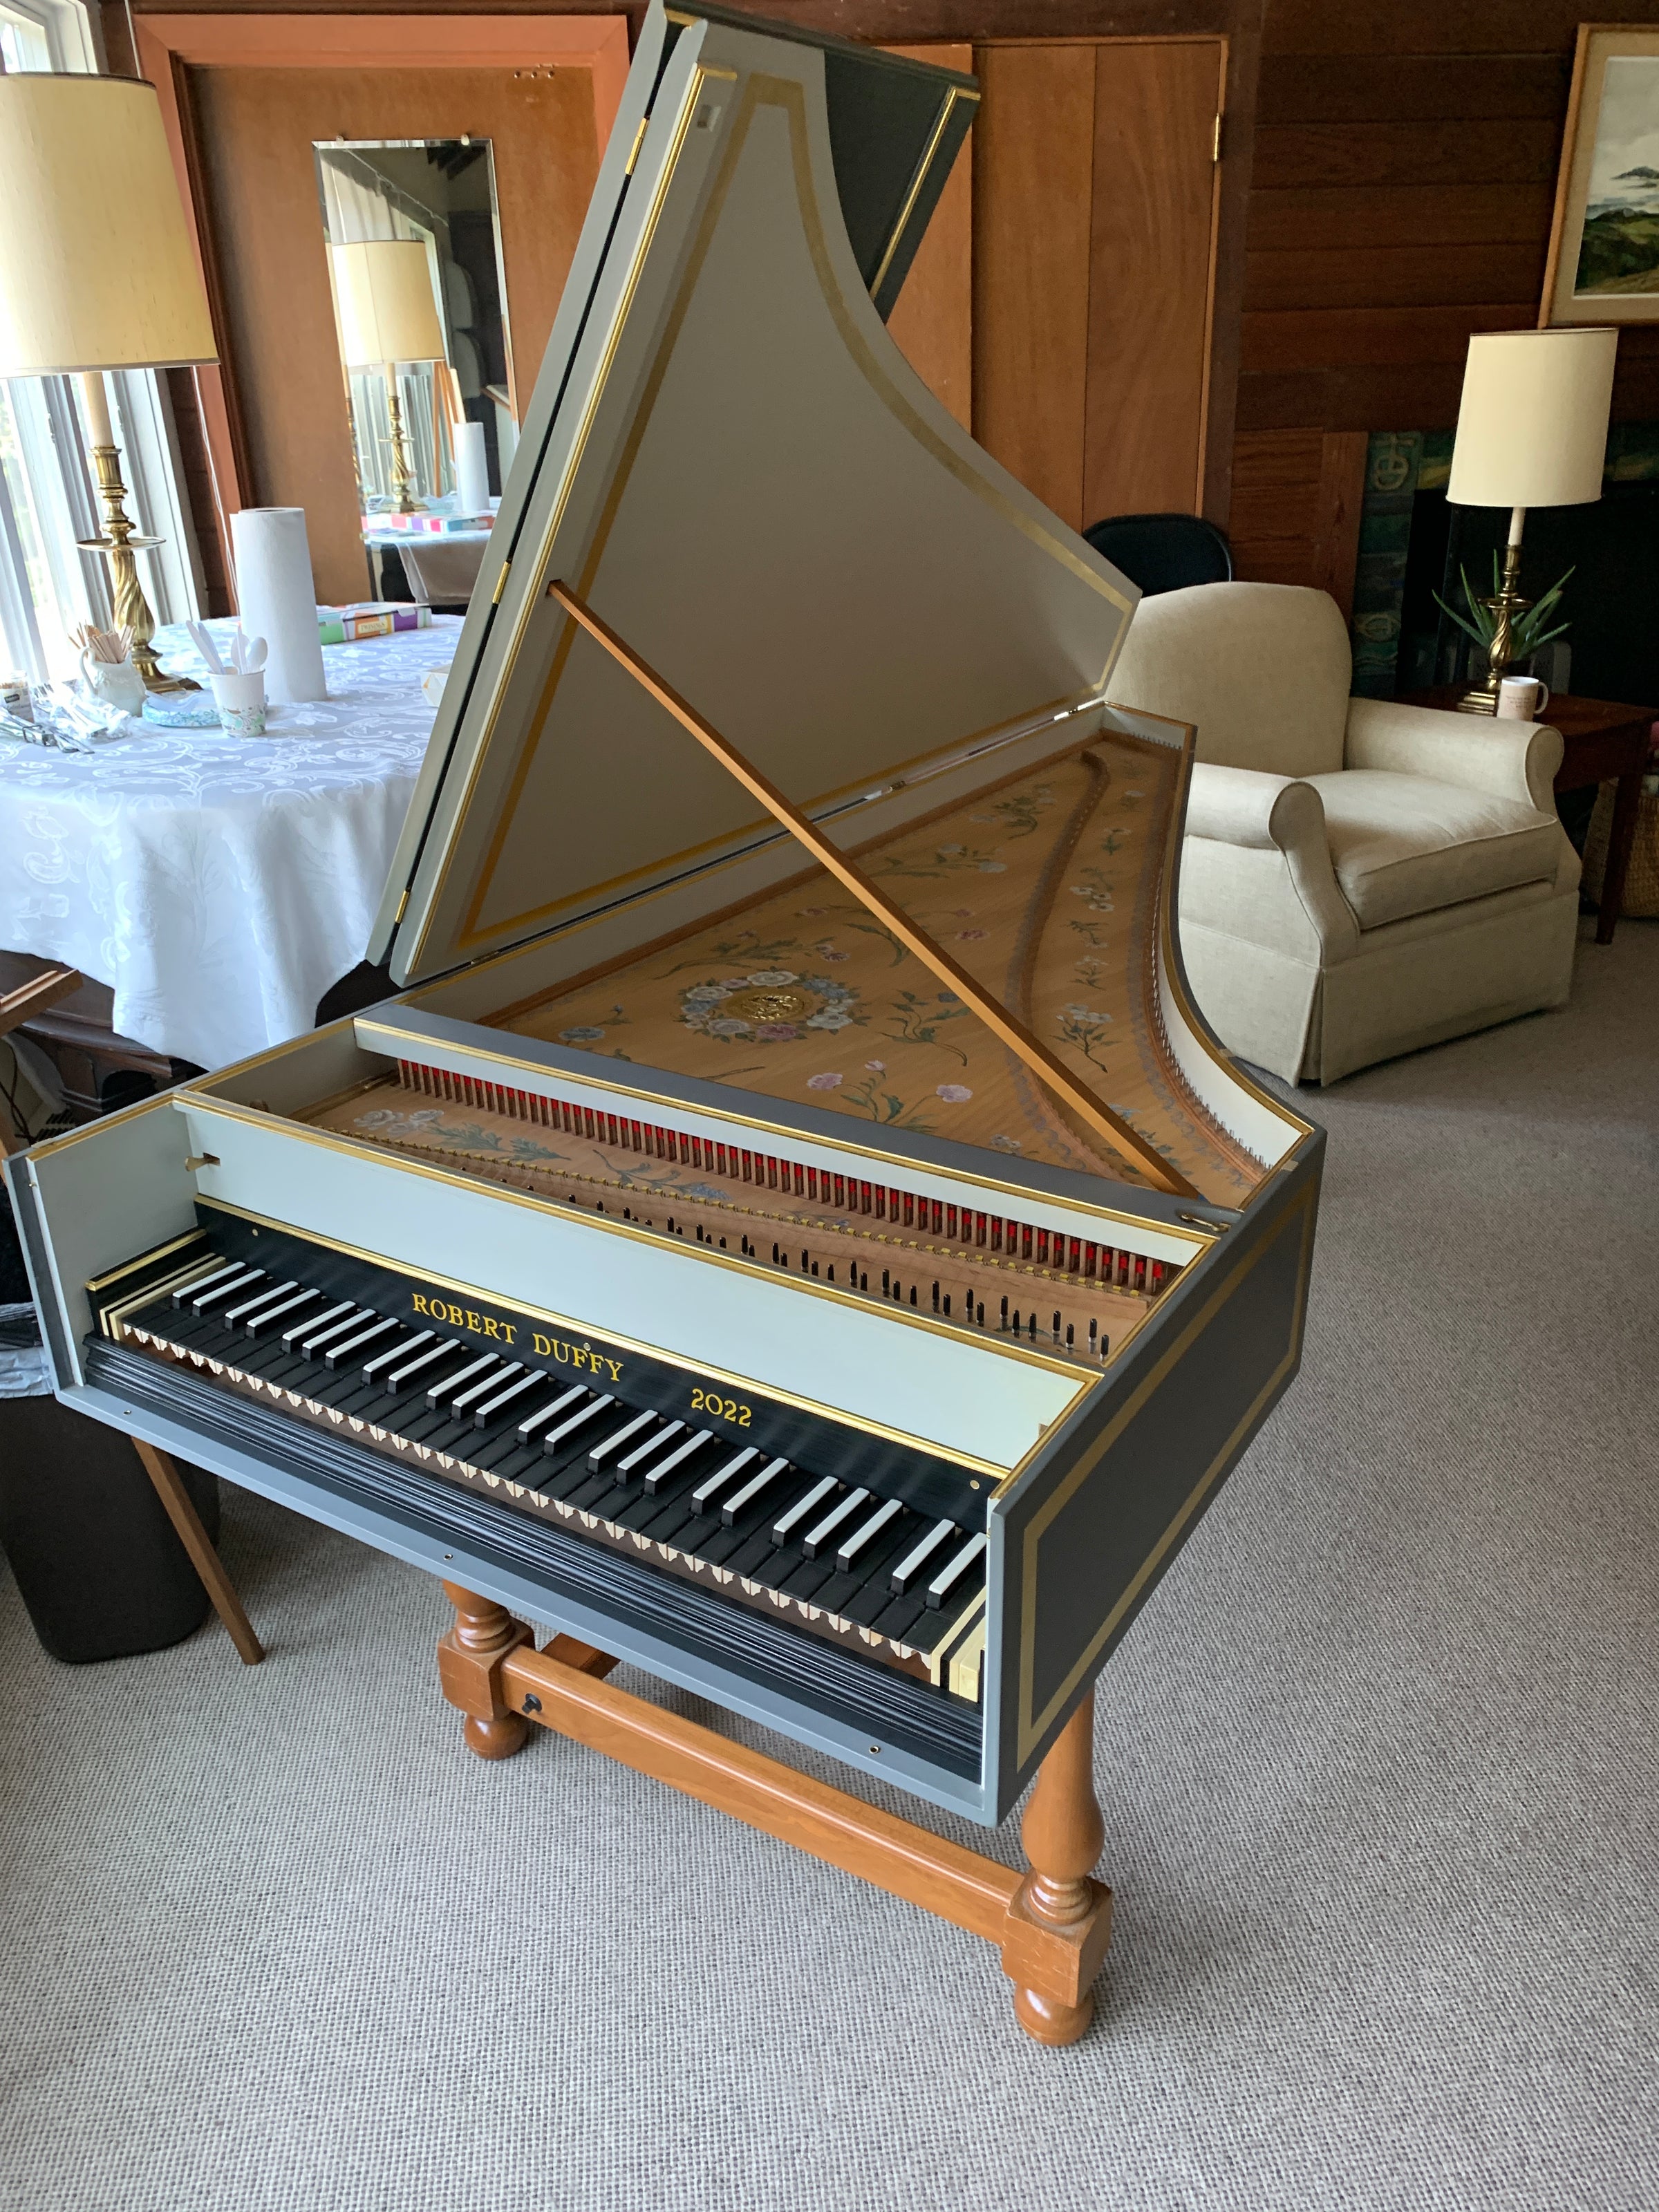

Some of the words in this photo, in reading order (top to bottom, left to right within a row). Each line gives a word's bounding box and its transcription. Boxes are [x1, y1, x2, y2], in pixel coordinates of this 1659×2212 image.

[413, 1293, 517, 1344] ROBERT
[533, 1333, 624, 1382] DUFFY
[691, 1388, 752, 1427] 2022
